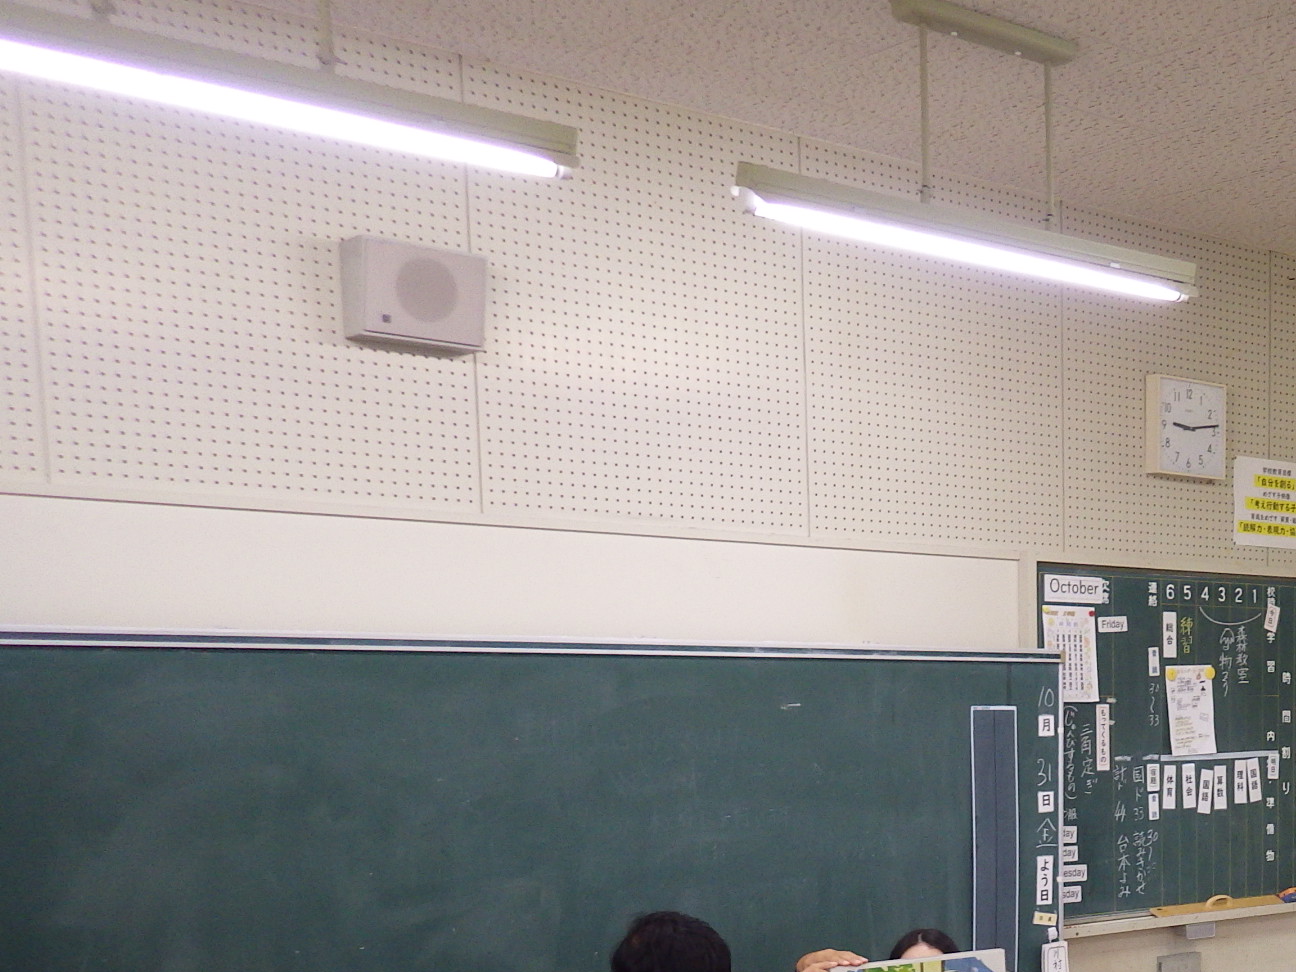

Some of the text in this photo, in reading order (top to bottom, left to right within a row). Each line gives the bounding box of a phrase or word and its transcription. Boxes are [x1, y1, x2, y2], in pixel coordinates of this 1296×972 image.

[1186, 388, 1193, 400] 12
[1165, 438, 1170, 448] 8
[1186, 458, 1191, 468] 6
[1199, 455, 1203, 465] 5
[1050, 578, 1099, 594] October
[1166, 584, 1175, 599] 6
[1184, 585, 1192, 599] 5
[1201, 587, 1209, 601] 4
[1218, 587, 1225, 601] 3
[1235, 588, 1242, 603] 2
[1101, 620, 1124, 630] Friday
[1180, 617, 1193, 653] 練習
[1038, 686, 1054, 707] 10
[1042, 718, 1050, 731] 月
[1037, 759, 1051, 786] 31
[1236, 771, 1244, 791] 理科
[1167, 776, 1173, 797] 体育
[1185, 775, 1193, 796] 社会
[1216, 775, 1224, 797] 算数
[1042, 794, 1050, 806] 日
[1036, 818, 1058, 848] 金
